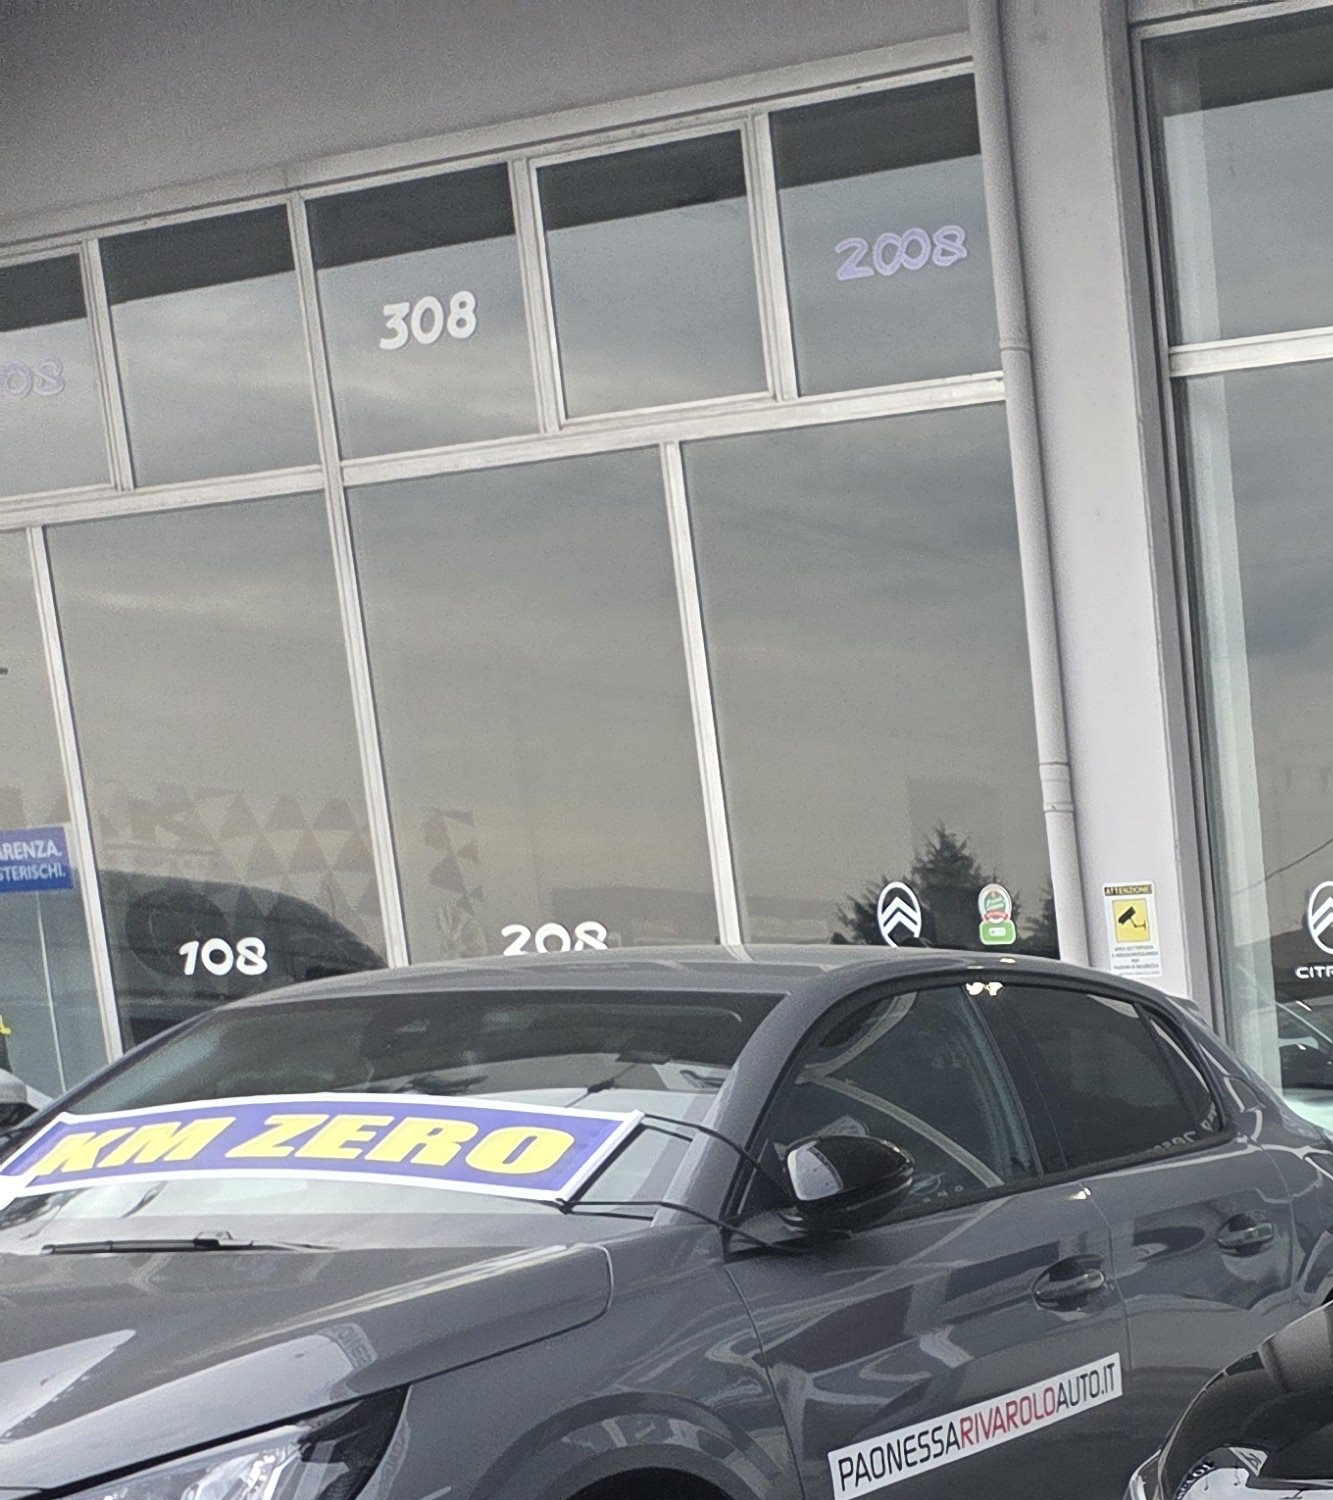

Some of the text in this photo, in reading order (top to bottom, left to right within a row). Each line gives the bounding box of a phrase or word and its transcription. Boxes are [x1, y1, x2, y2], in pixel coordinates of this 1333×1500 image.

[834, 225, 967, 281] 2008
[379, 290, 477, 350] 308
[178, 936, 268, 976] 108
[36, 1113, 575, 1176] KM ZERO
[837, 1362, 1116, 1492] PAONESSARIVAROLOAUTO.IT
